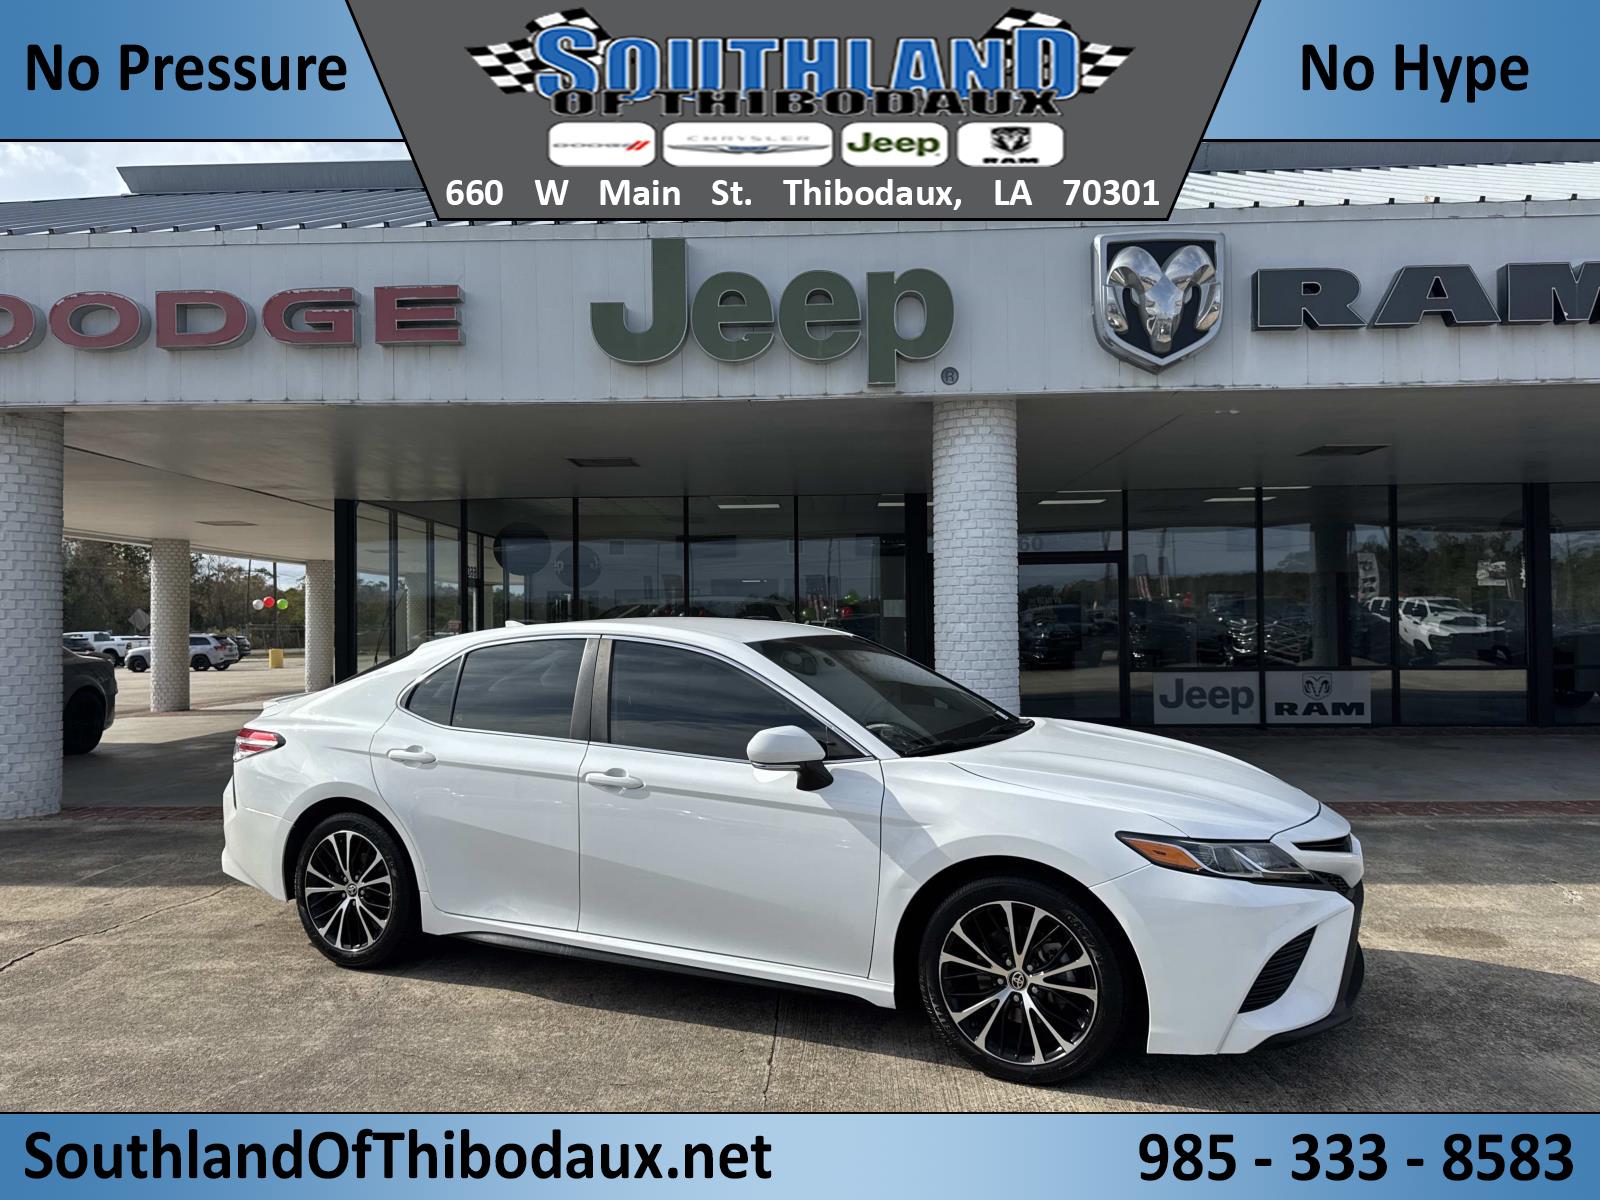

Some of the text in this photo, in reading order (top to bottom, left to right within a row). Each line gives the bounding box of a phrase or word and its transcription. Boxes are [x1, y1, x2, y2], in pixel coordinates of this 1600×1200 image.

[590, 238, 955, 387] Jeep
[1251, 262, 1600, 331] RAM
[1159, 678, 1254, 715] Jeep
[1274, 702, 1365, 716] RAM
